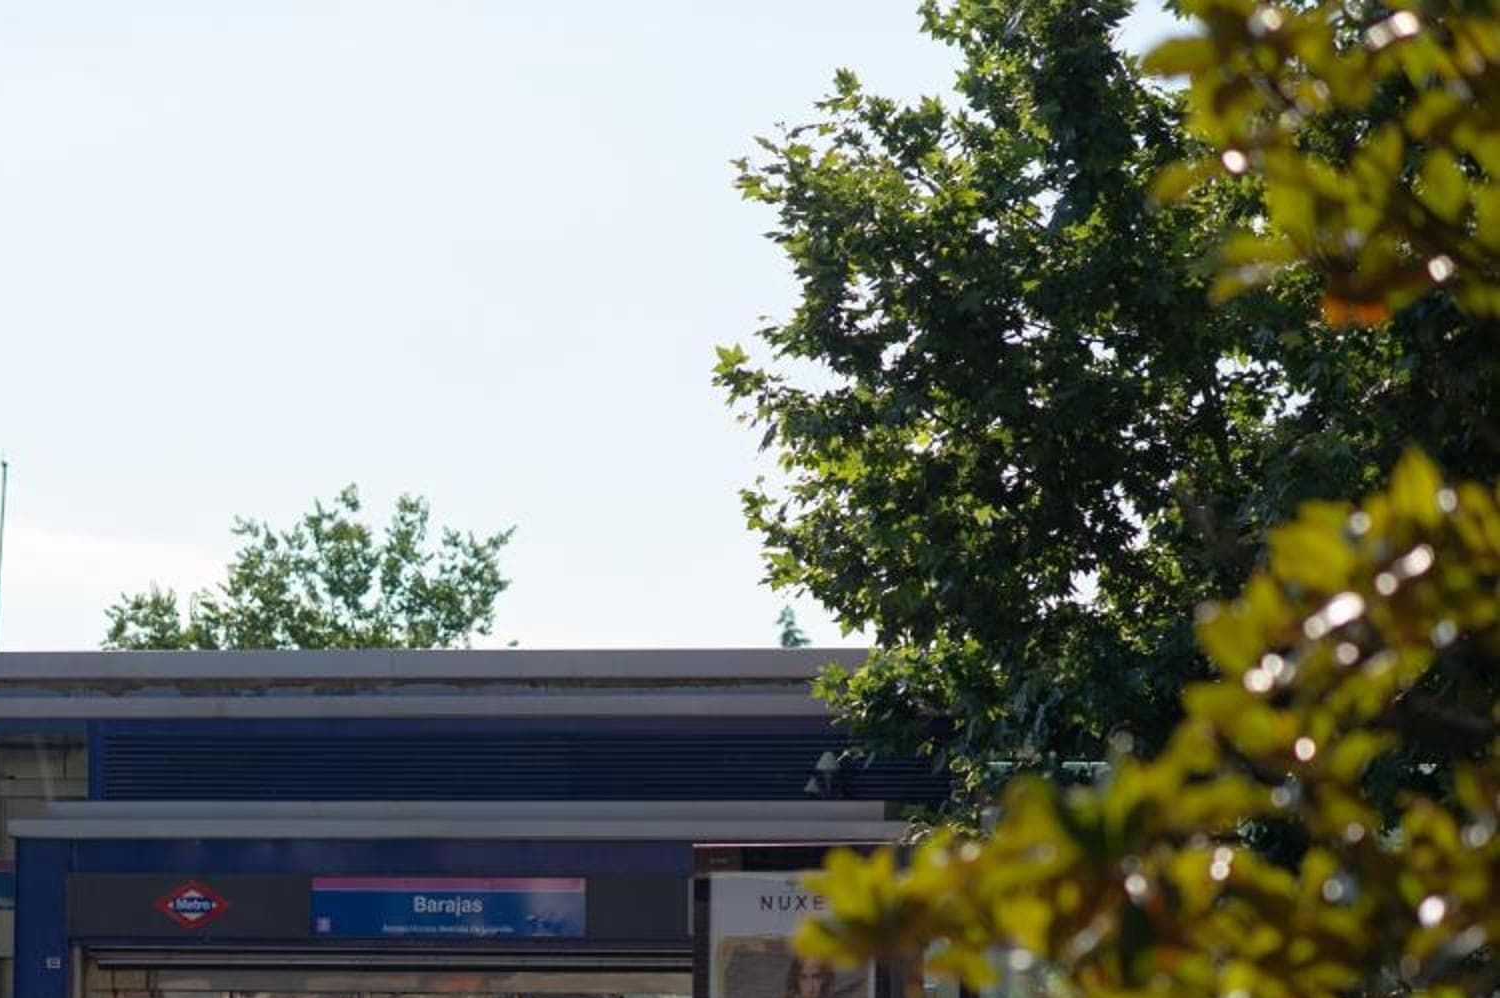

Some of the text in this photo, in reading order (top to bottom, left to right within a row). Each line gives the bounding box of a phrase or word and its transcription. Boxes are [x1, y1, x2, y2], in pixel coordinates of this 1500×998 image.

[175, 898, 211, 910] Metro
[412, 895, 484, 917] Barajas
[760, 895, 827, 911] NUXE
